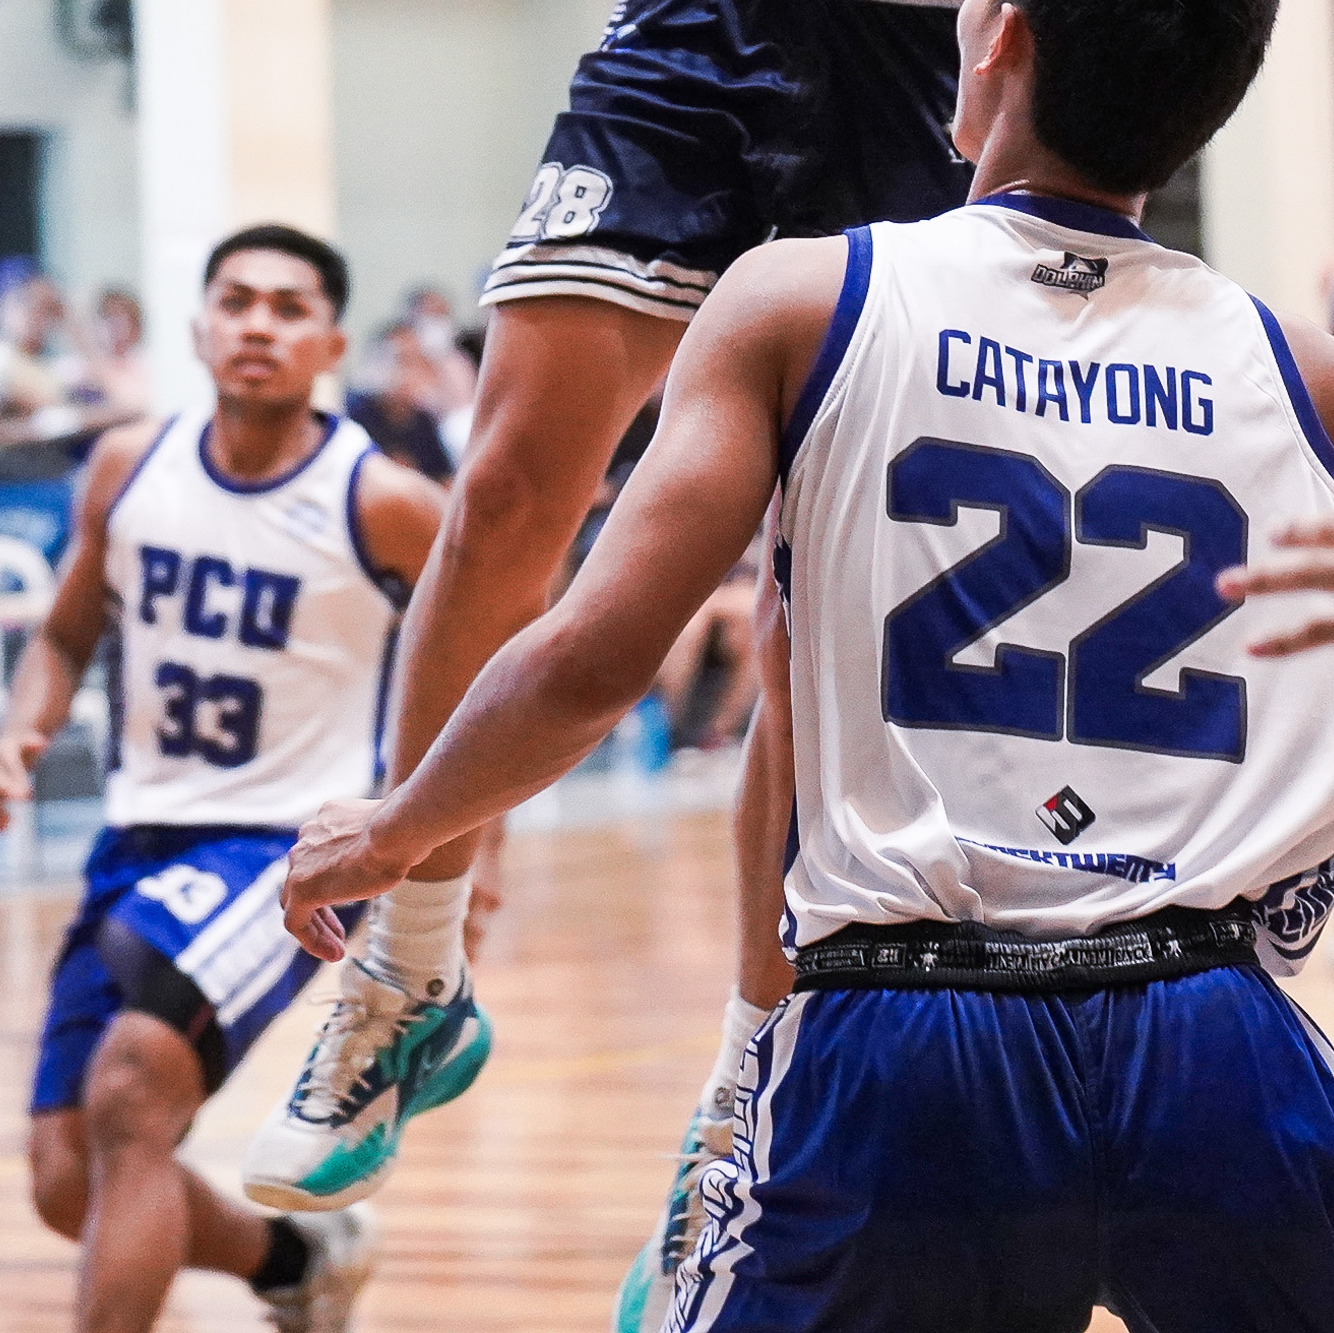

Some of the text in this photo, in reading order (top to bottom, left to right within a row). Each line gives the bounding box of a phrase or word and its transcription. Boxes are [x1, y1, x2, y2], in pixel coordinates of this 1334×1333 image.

[508, 161, 614, 242] 28
[936, 328, 1215, 437] CATAYONG
[882, 436, 1249, 764] 22
[155, 662, 264, 769] 33
